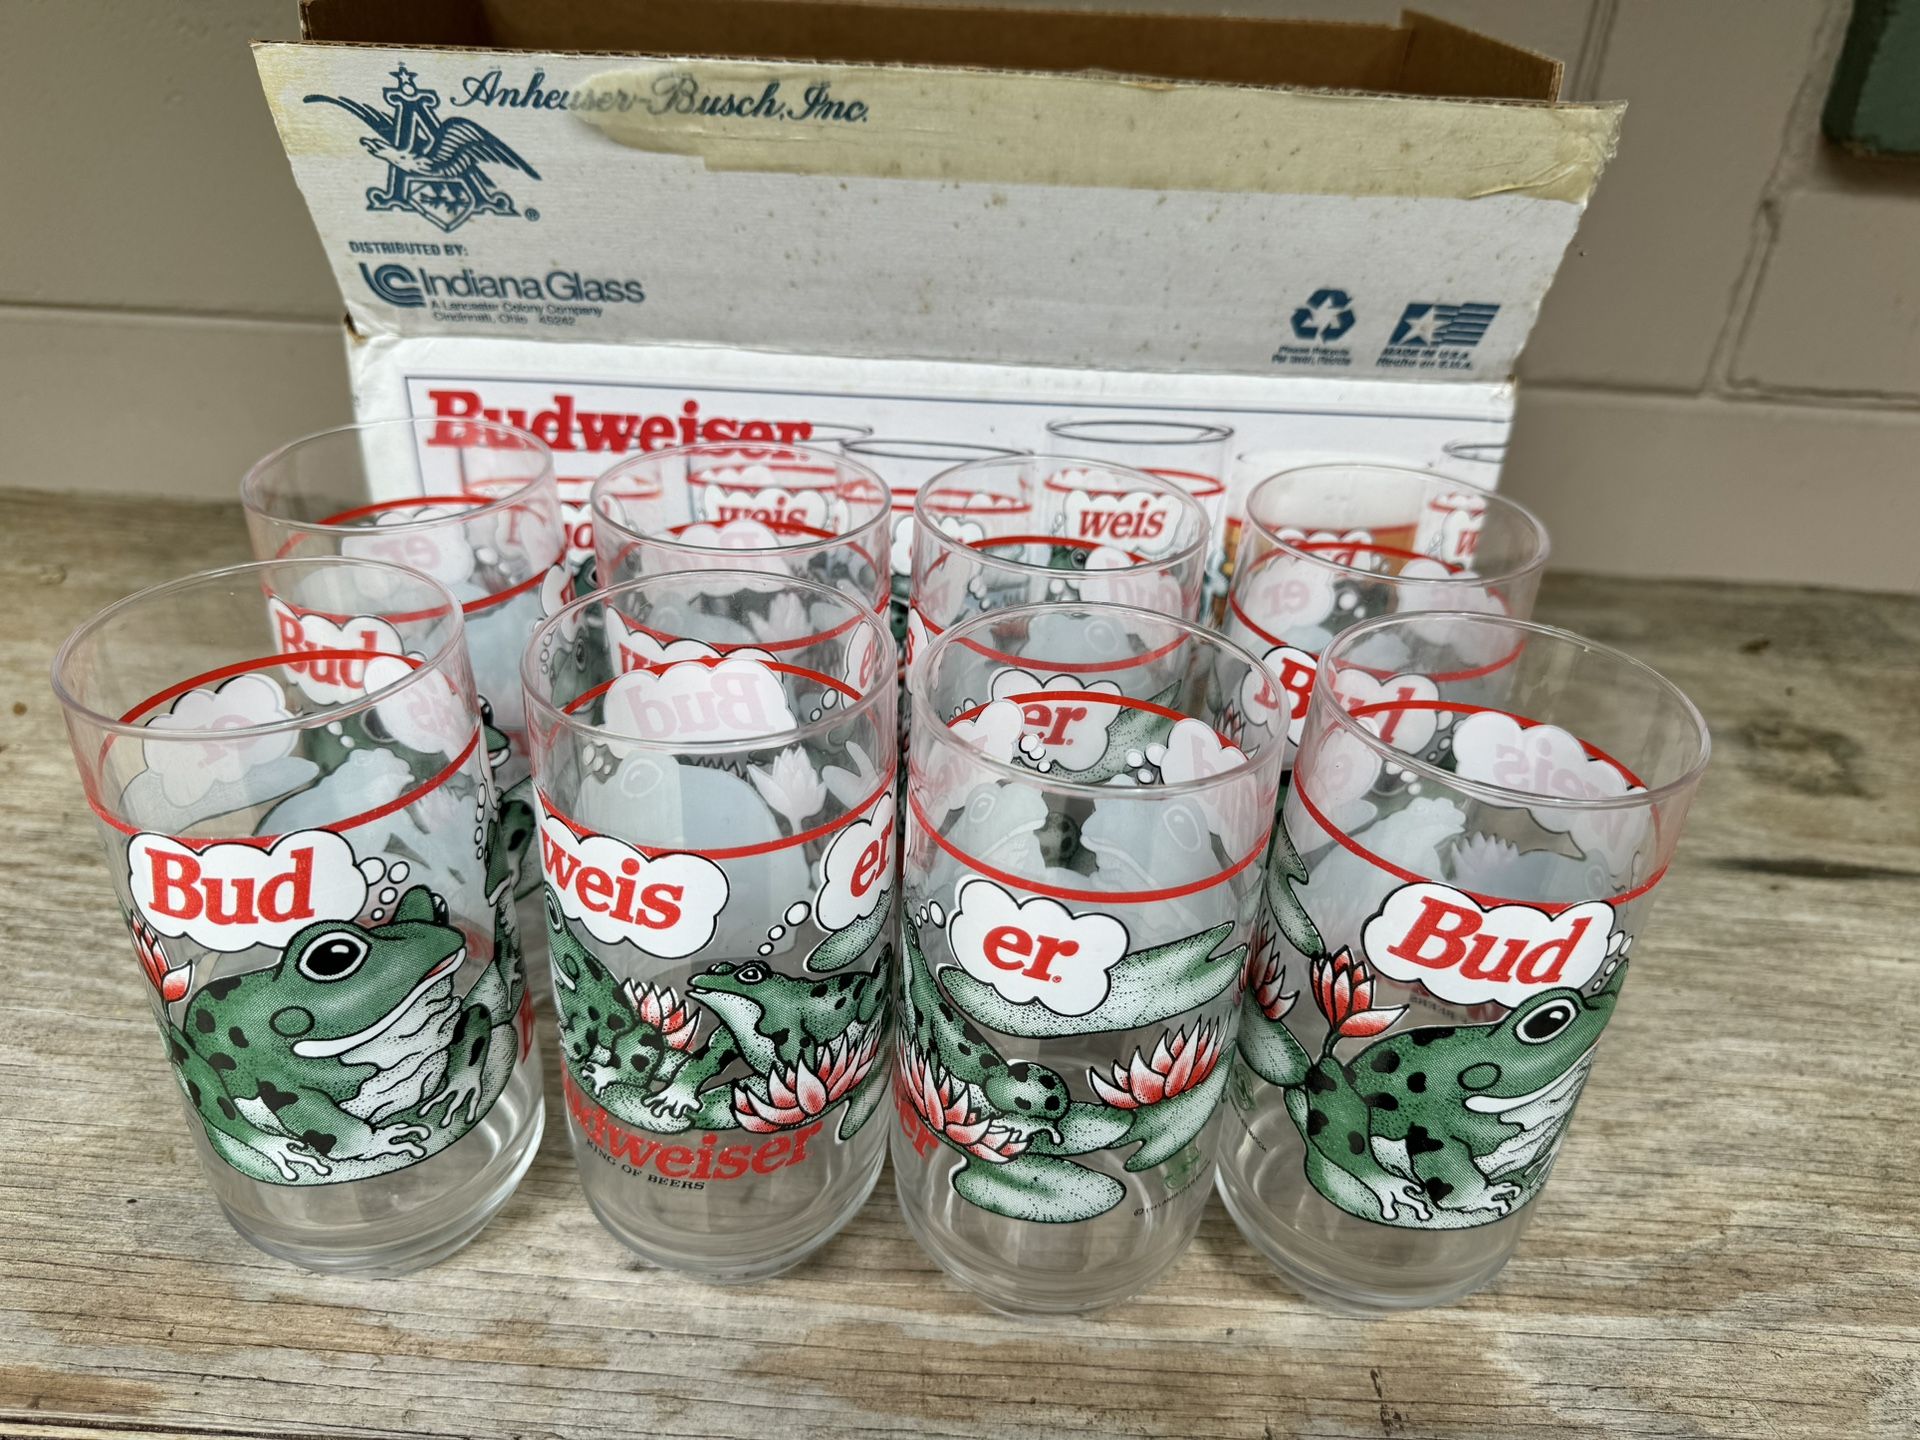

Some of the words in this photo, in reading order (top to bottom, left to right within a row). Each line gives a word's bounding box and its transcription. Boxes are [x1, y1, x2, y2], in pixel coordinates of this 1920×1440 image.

[787, 81, 869, 123] Inc.
[348, 241, 441, 256] DISTRIBUTED
[443, 244, 469, 257] BY:
[419, 267, 546, 301] Indiana
[546, 270, 646, 303] Glass
[547, 305, 603, 317] Company
[427, 390, 813, 460] Budweiser
[1078, 500, 1168, 540] weis
[275, 610, 379, 690] Bud
[144, 846, 316, 926] Bud
[541, 824, 685, 931] weis
[1388, 895, 1593, 986] Bud
[586, 1137, 617, 1166] KING
[621, 1162, 643, 1178] OF
[648, 1173, 706, 1191] BEERS
